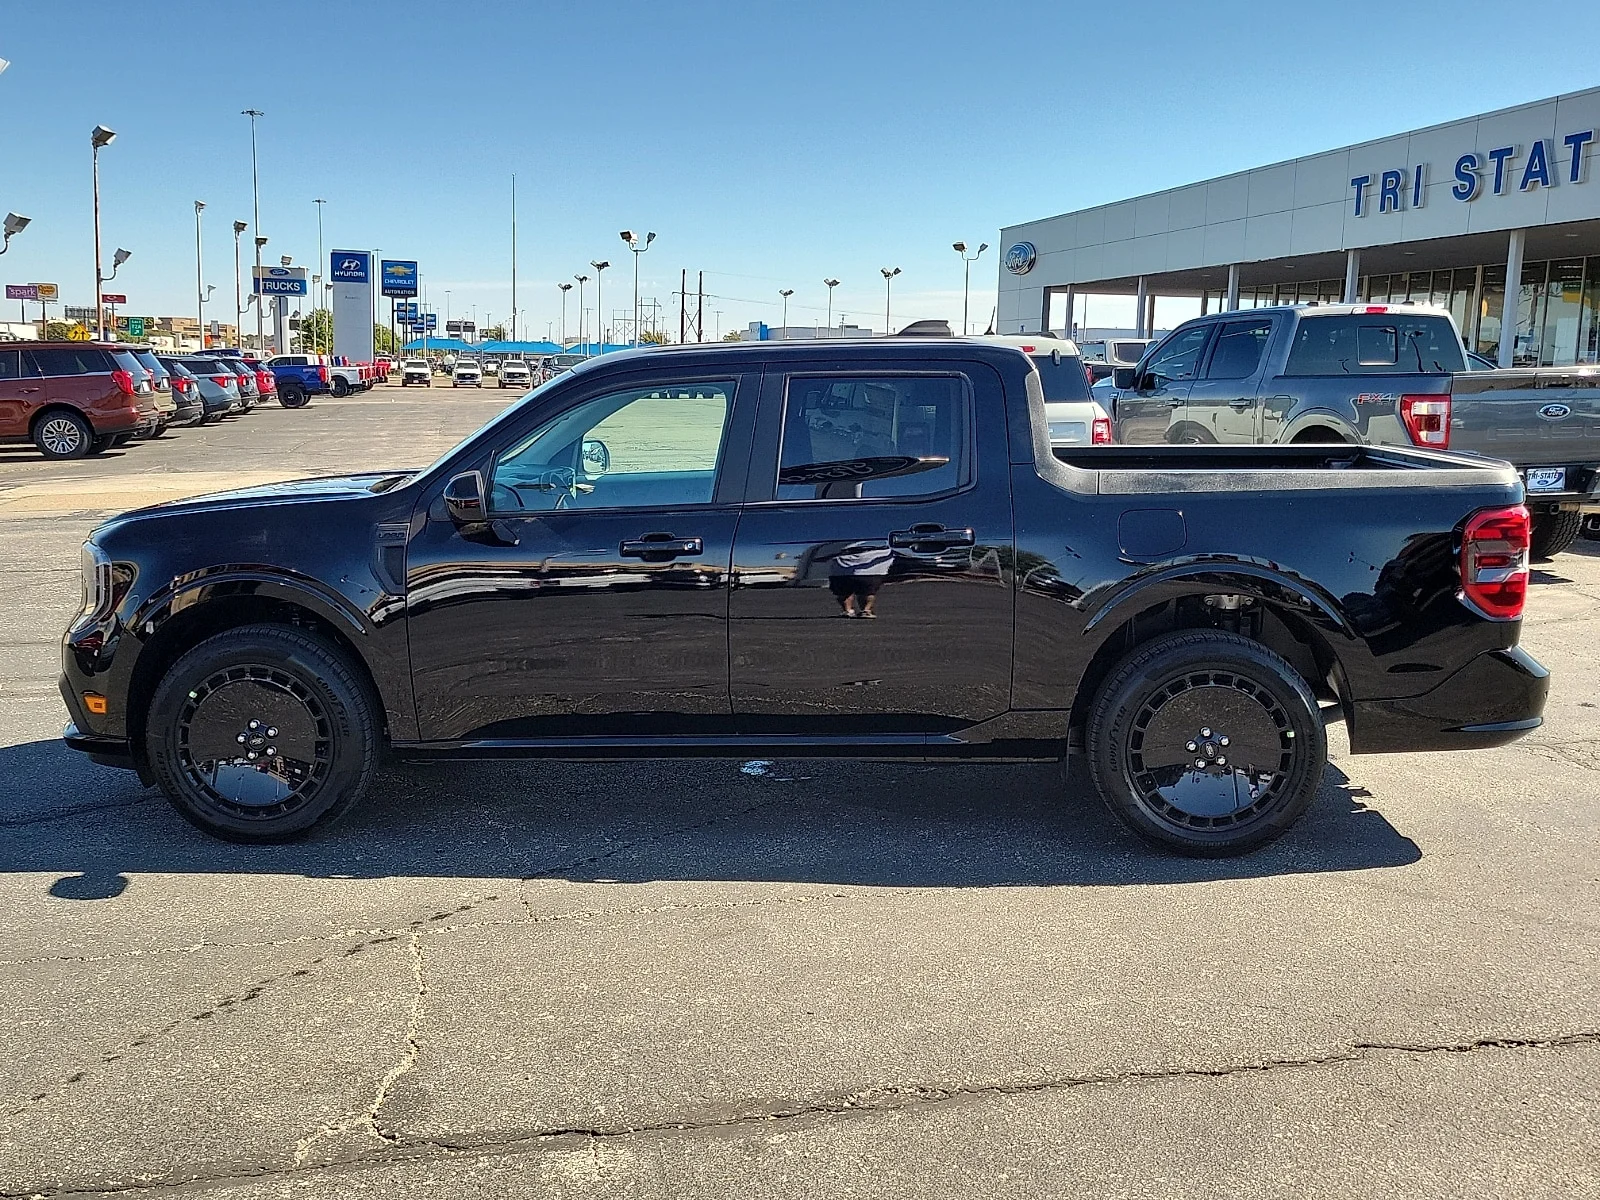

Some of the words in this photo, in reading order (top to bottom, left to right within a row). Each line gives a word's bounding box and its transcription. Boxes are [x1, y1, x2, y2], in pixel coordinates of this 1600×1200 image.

[1350, 162, 1425, 218] TRI
[262, 281, 301, 291] TRUCKS
[10, 287, 36, 297] spark
[1357, 393, 1393, 405] FX4
